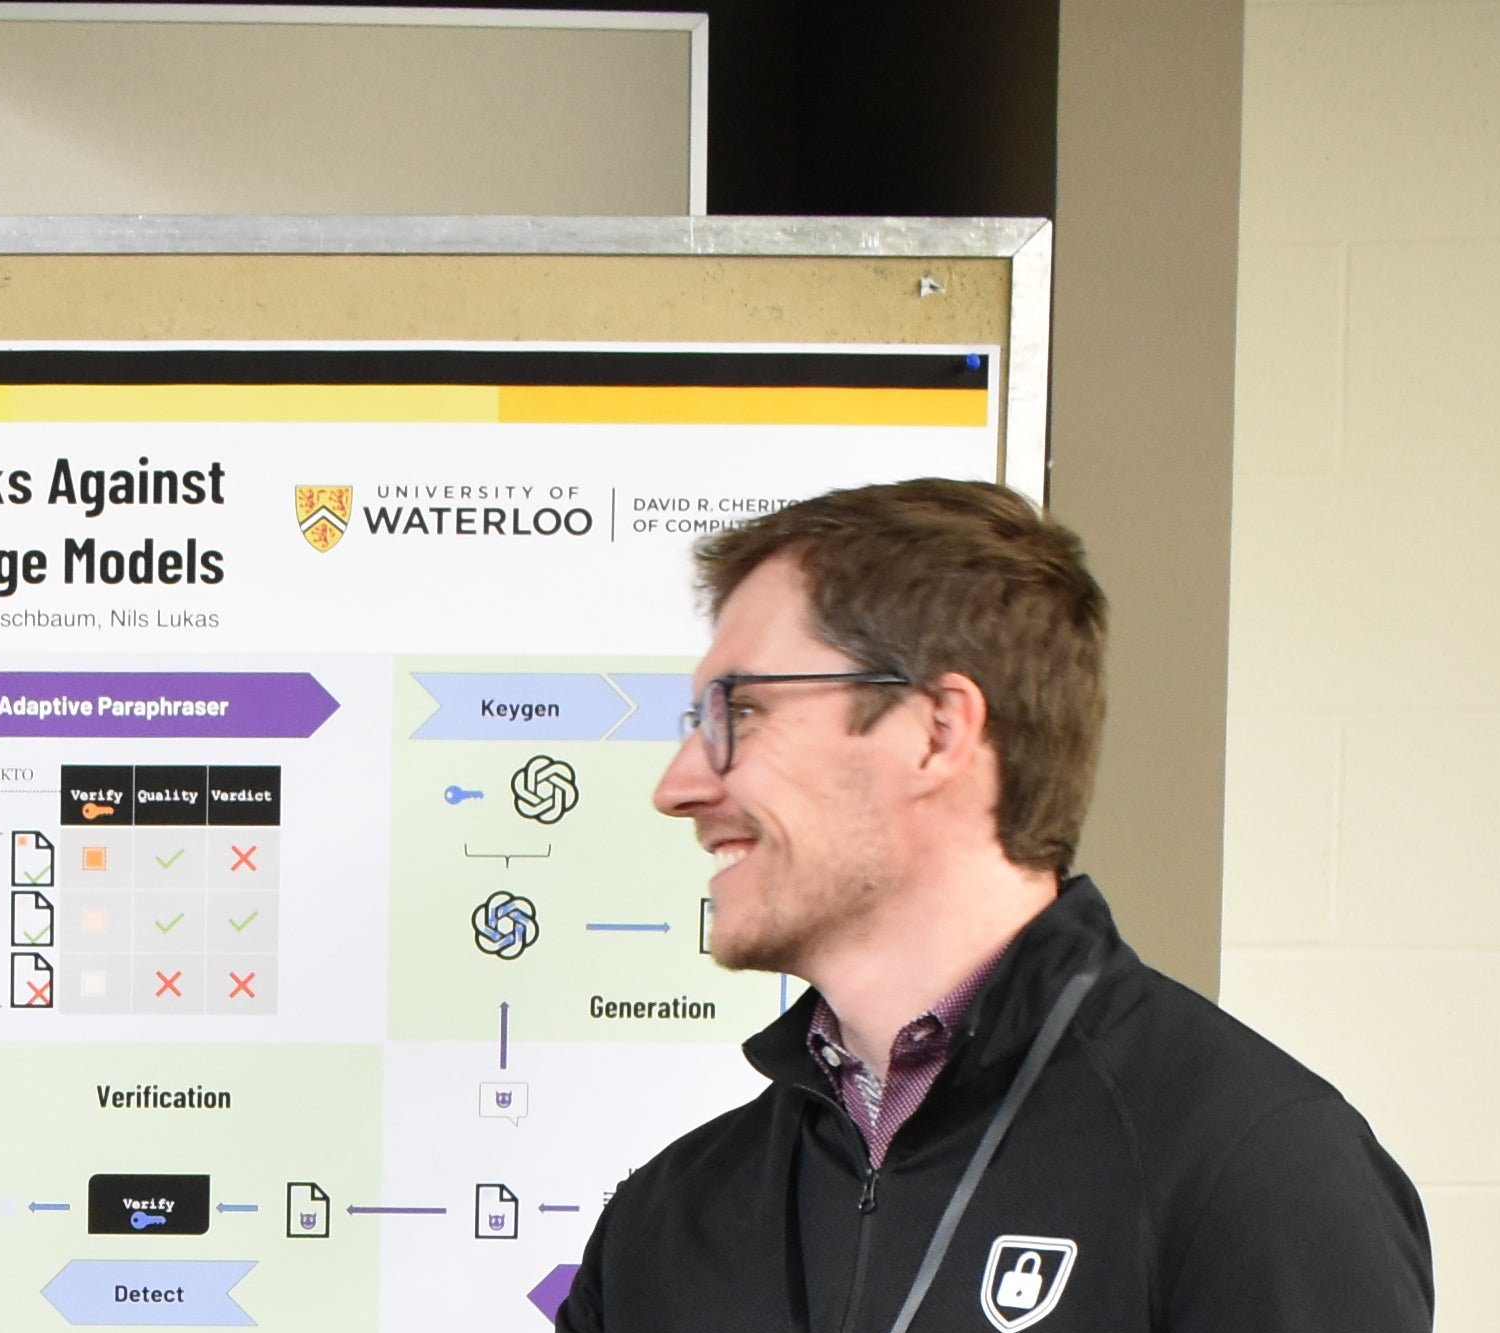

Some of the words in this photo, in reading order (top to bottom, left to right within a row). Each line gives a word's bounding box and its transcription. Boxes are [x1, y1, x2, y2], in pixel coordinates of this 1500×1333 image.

[47, 456, 226, 519] Against
[377, 485, 533, 500] UNIVERSITY
[549, 486, 579, 500] OF
[634, 499, 690, 512] DAVID
[698, 499, 713, 512] R.
[719, 499, 806, 512] CHERIT
[362, 506, 593, 537] WATERLOO
[633, 520, 658, 532] OF
[64, 537, 225, 585] Models
[110, 609, 149, 628] Nils
[157, 609, 220, 628] Lukas
[97, 696, 230, 721] Paraphraser
[481, 699, 560, 722] Keygen
[70, 789, 124, 805] Verify
[137, 789, 199, 805] Quality
[211, 789, 273, 802] Verdict
[590, 995, 716, 1020] Generation
[96, 1084, 231, 1109] Verification
[122, 1197, 175, 1213] Verify
[114, 1285, 185, 1303] Detect
